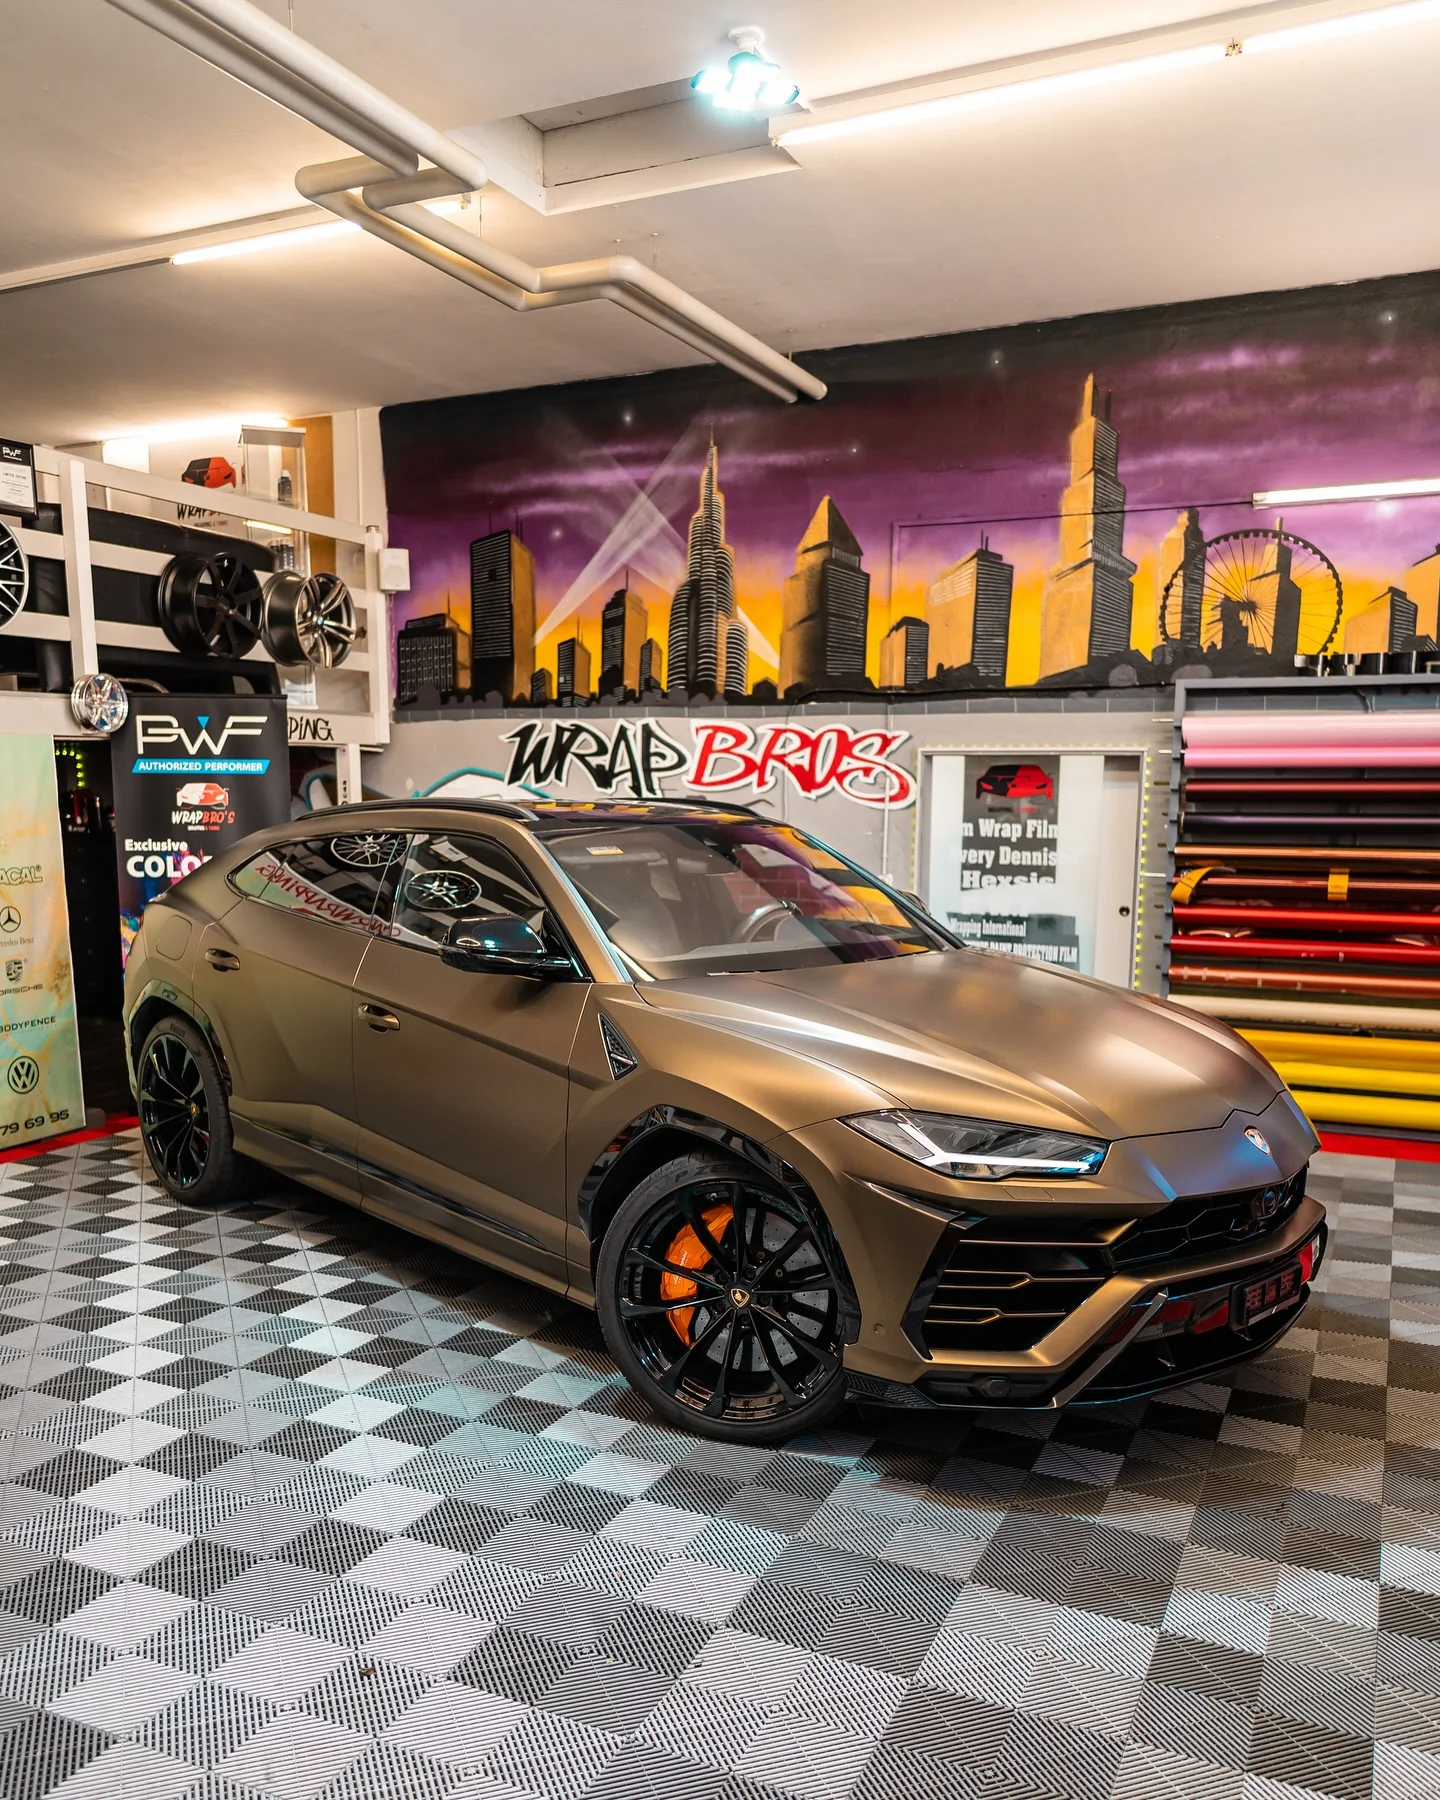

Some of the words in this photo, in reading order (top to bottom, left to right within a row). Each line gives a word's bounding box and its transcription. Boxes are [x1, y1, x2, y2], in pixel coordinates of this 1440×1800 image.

[136, 714, 268, 755] PWF
[138, 761, 202, 771] AUTHORIZED
[205, 762, 263, 772] PERFORMER
[501, 719, 687, 798] WRAP
[683, 720, 916, 810] BROS
[978, 818, 1022, 842] Wrap
[124, 838, 188, 851] Exclusive
[126, 855, 213, 878] COLO
[982, 919, 1026, 937] International
[1059, 945, 1078, 963] FILM
[0, 1122, 19, 1136] 79
[25, 1116, 45, 1129] 69
[50, 1109, 69, 1123] 95
